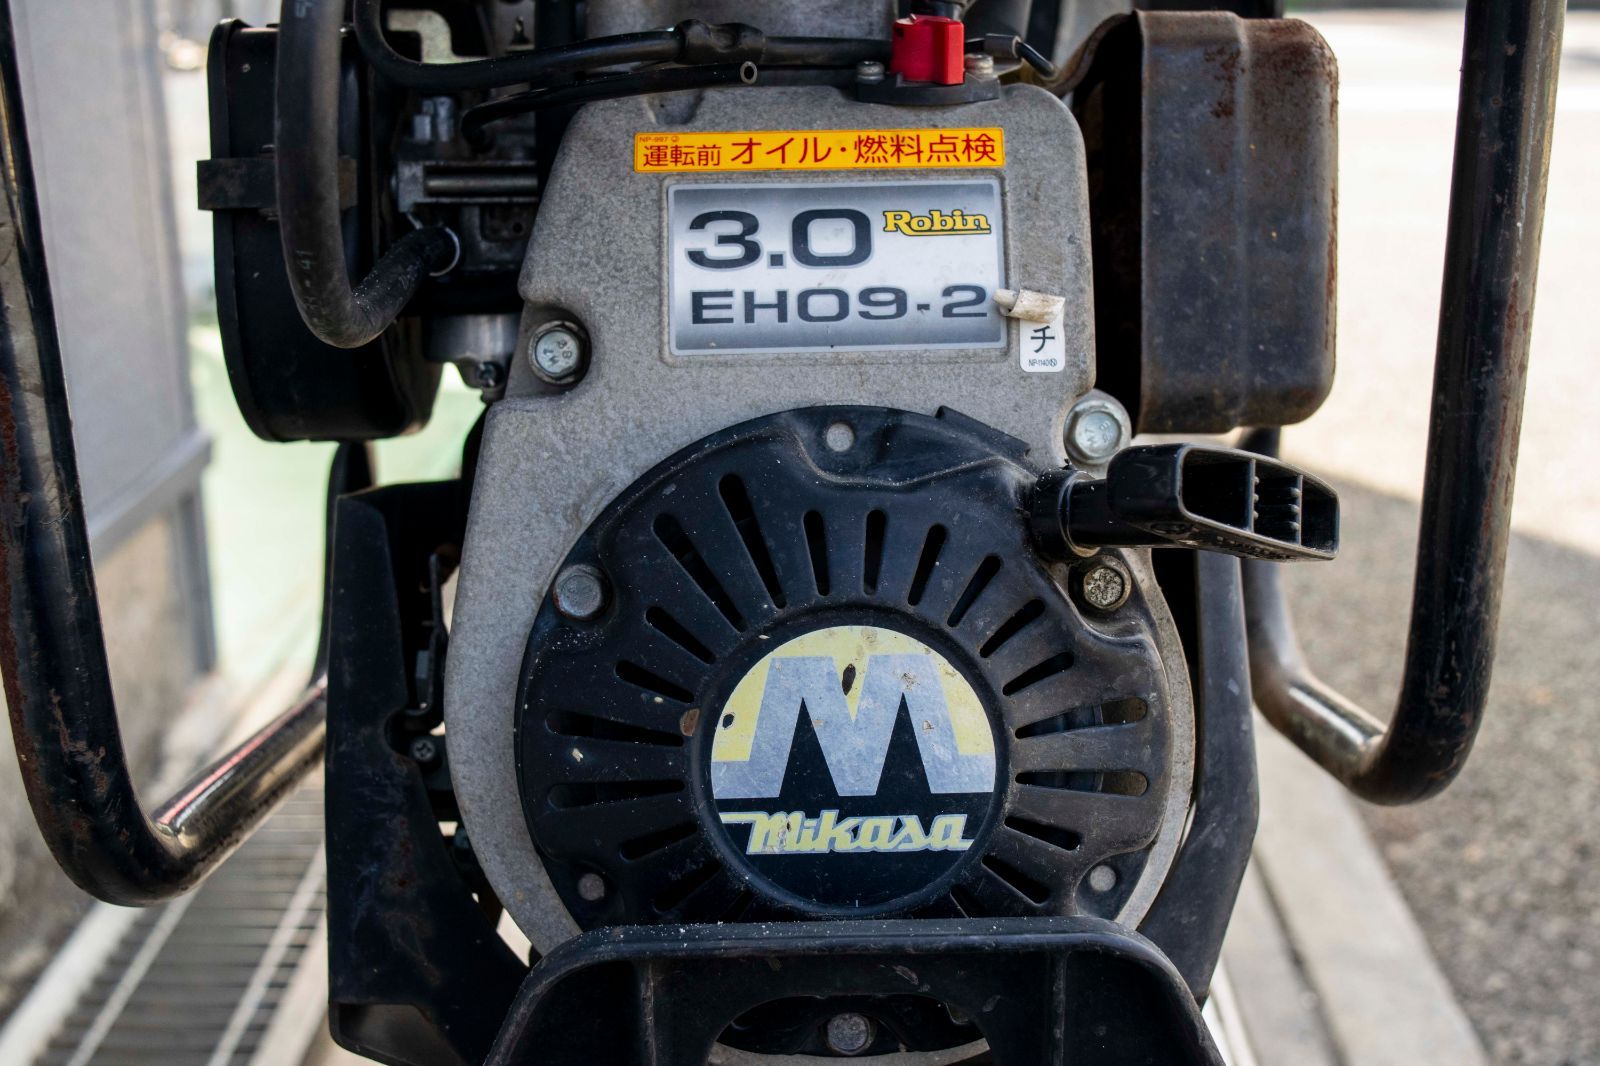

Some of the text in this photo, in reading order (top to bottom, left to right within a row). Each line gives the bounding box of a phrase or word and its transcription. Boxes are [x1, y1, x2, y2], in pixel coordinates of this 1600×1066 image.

[643, 133, 997, 167] 運転前 オイル・燃料点検
[687, 208, 992, 269] 3.0 Robin
[692, 285, 988, 325] EH09-2
[1030, 325, 1056, 353] チ
[718, 809, 975, 855] Mikasa
